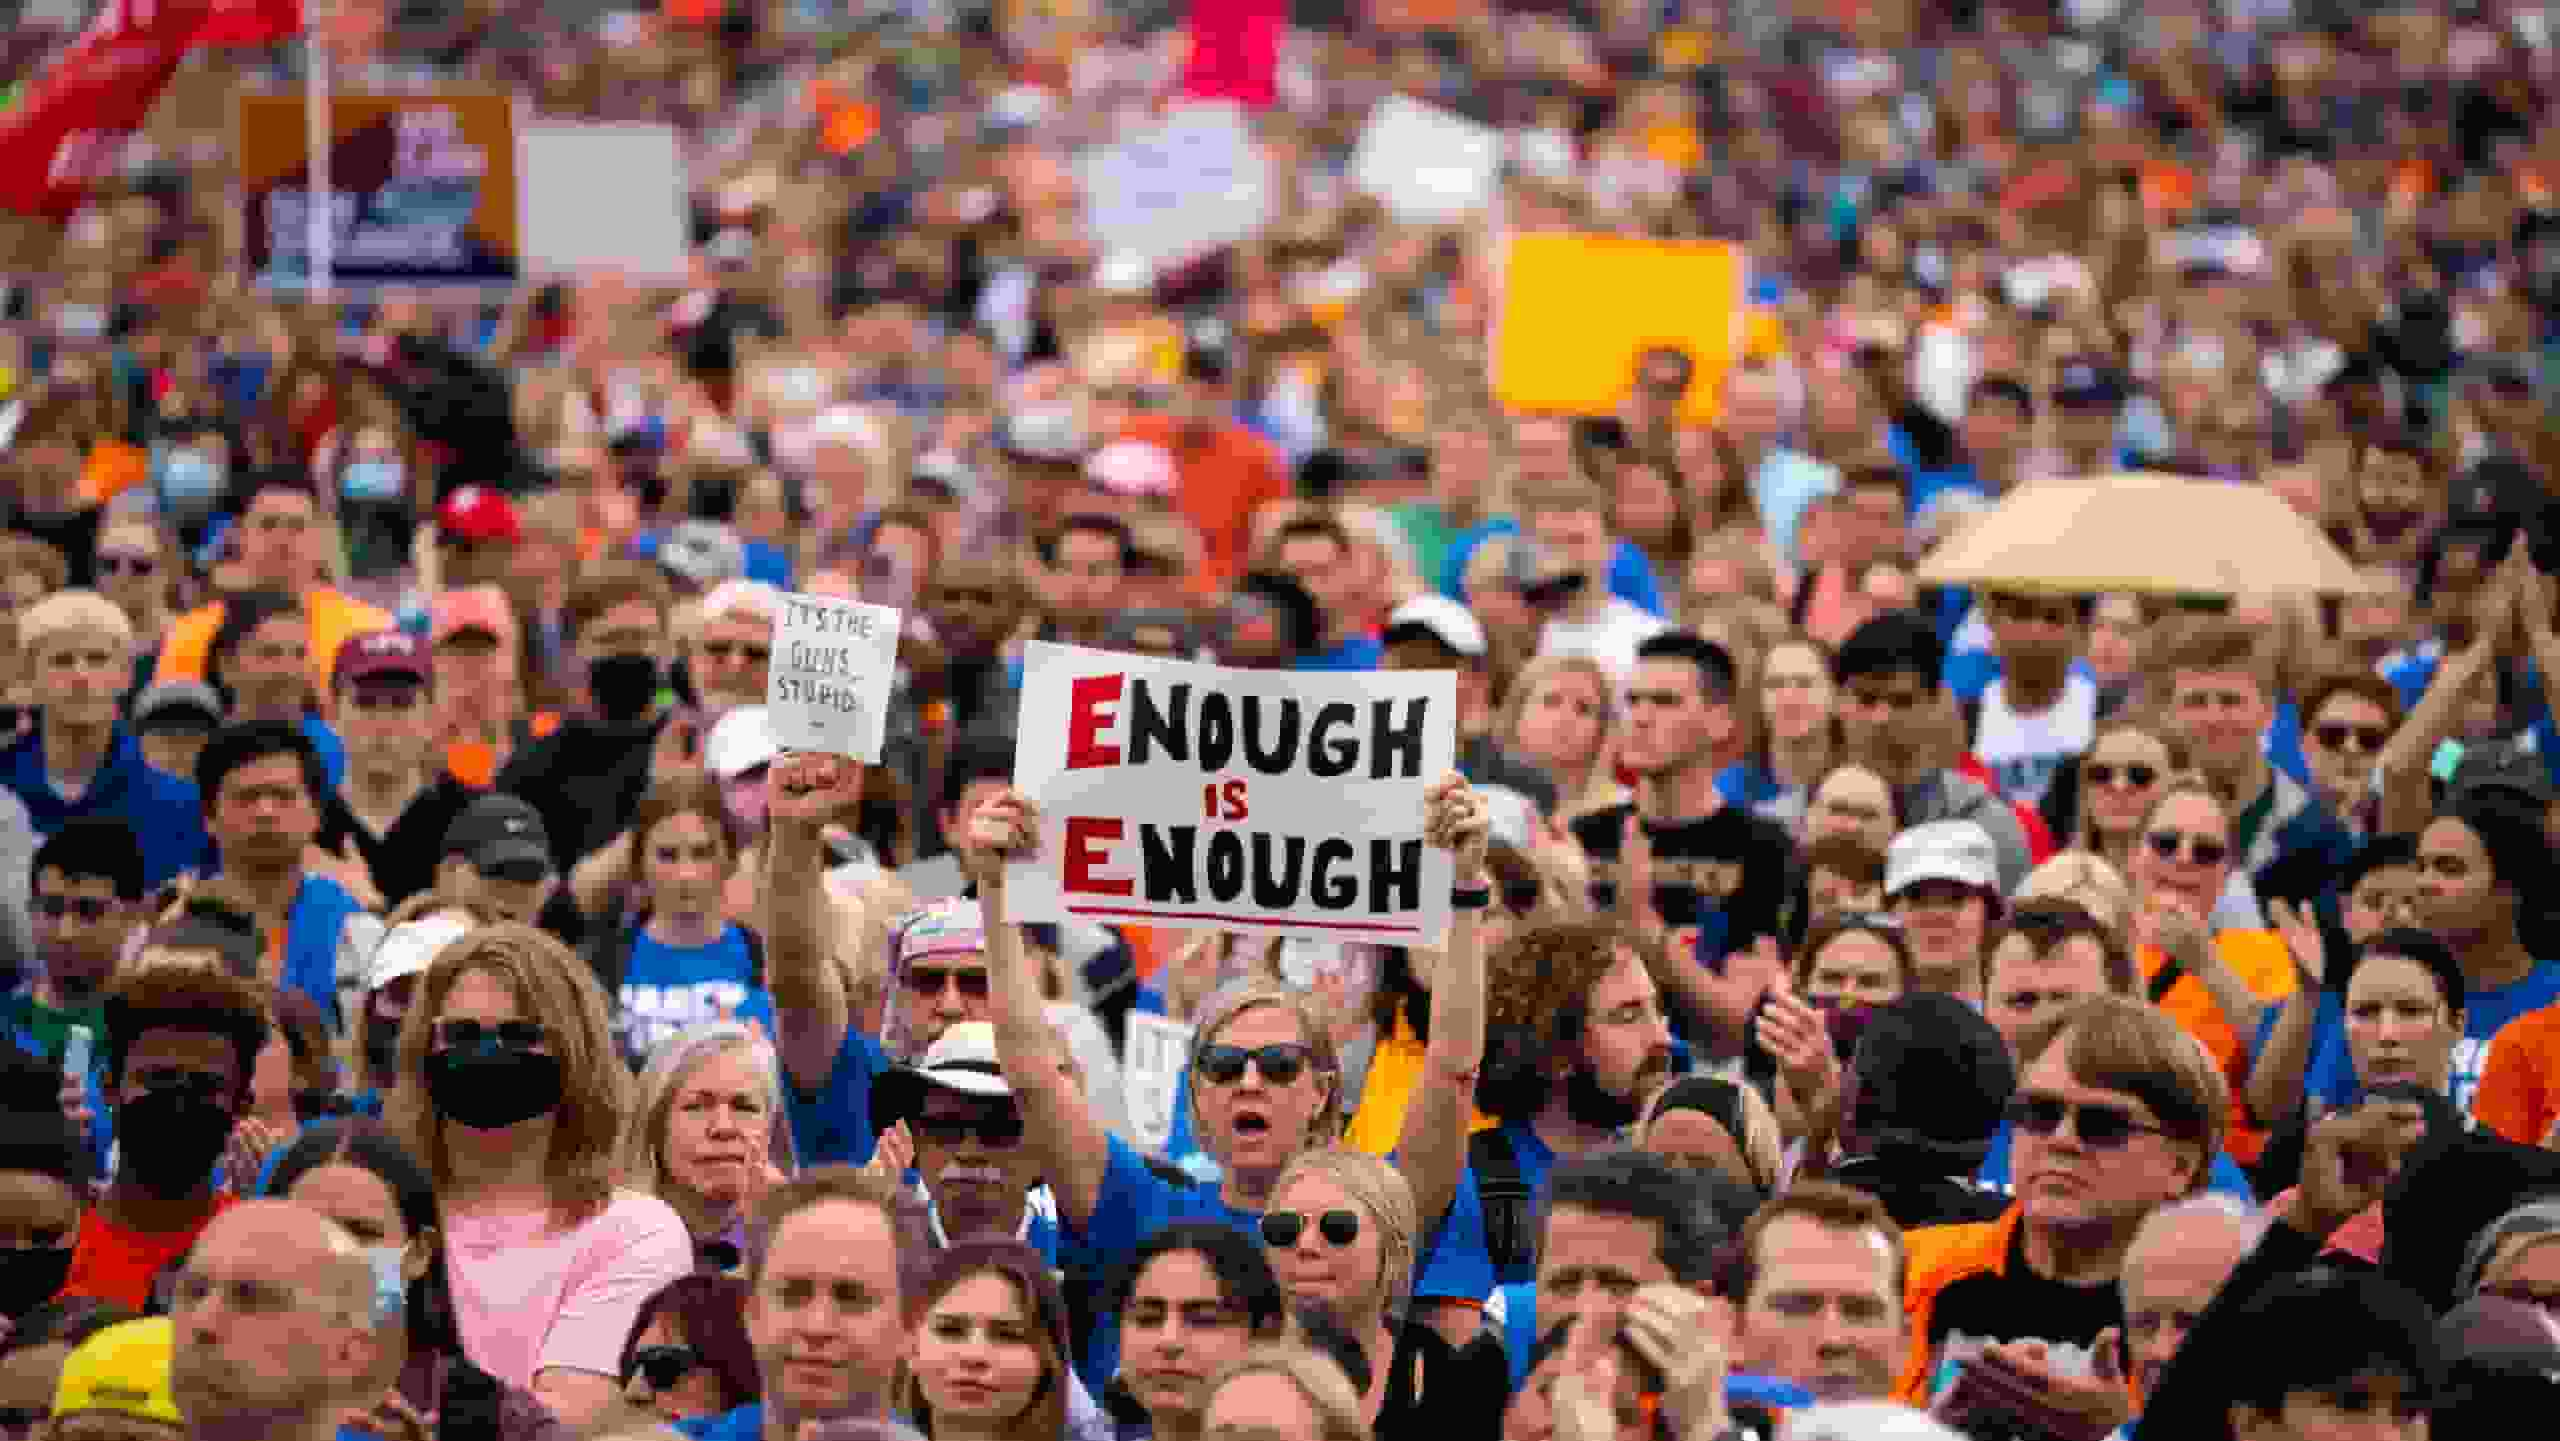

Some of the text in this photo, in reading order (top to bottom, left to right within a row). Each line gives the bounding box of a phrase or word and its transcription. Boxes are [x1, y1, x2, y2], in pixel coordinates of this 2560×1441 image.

[833, 606, 872, 639] THE
[1066, 671, 1430, 780] ENOUGH
[1204, 779, 1249, 821] IS
[1062, 816, 1423, 913] ENOUGH
